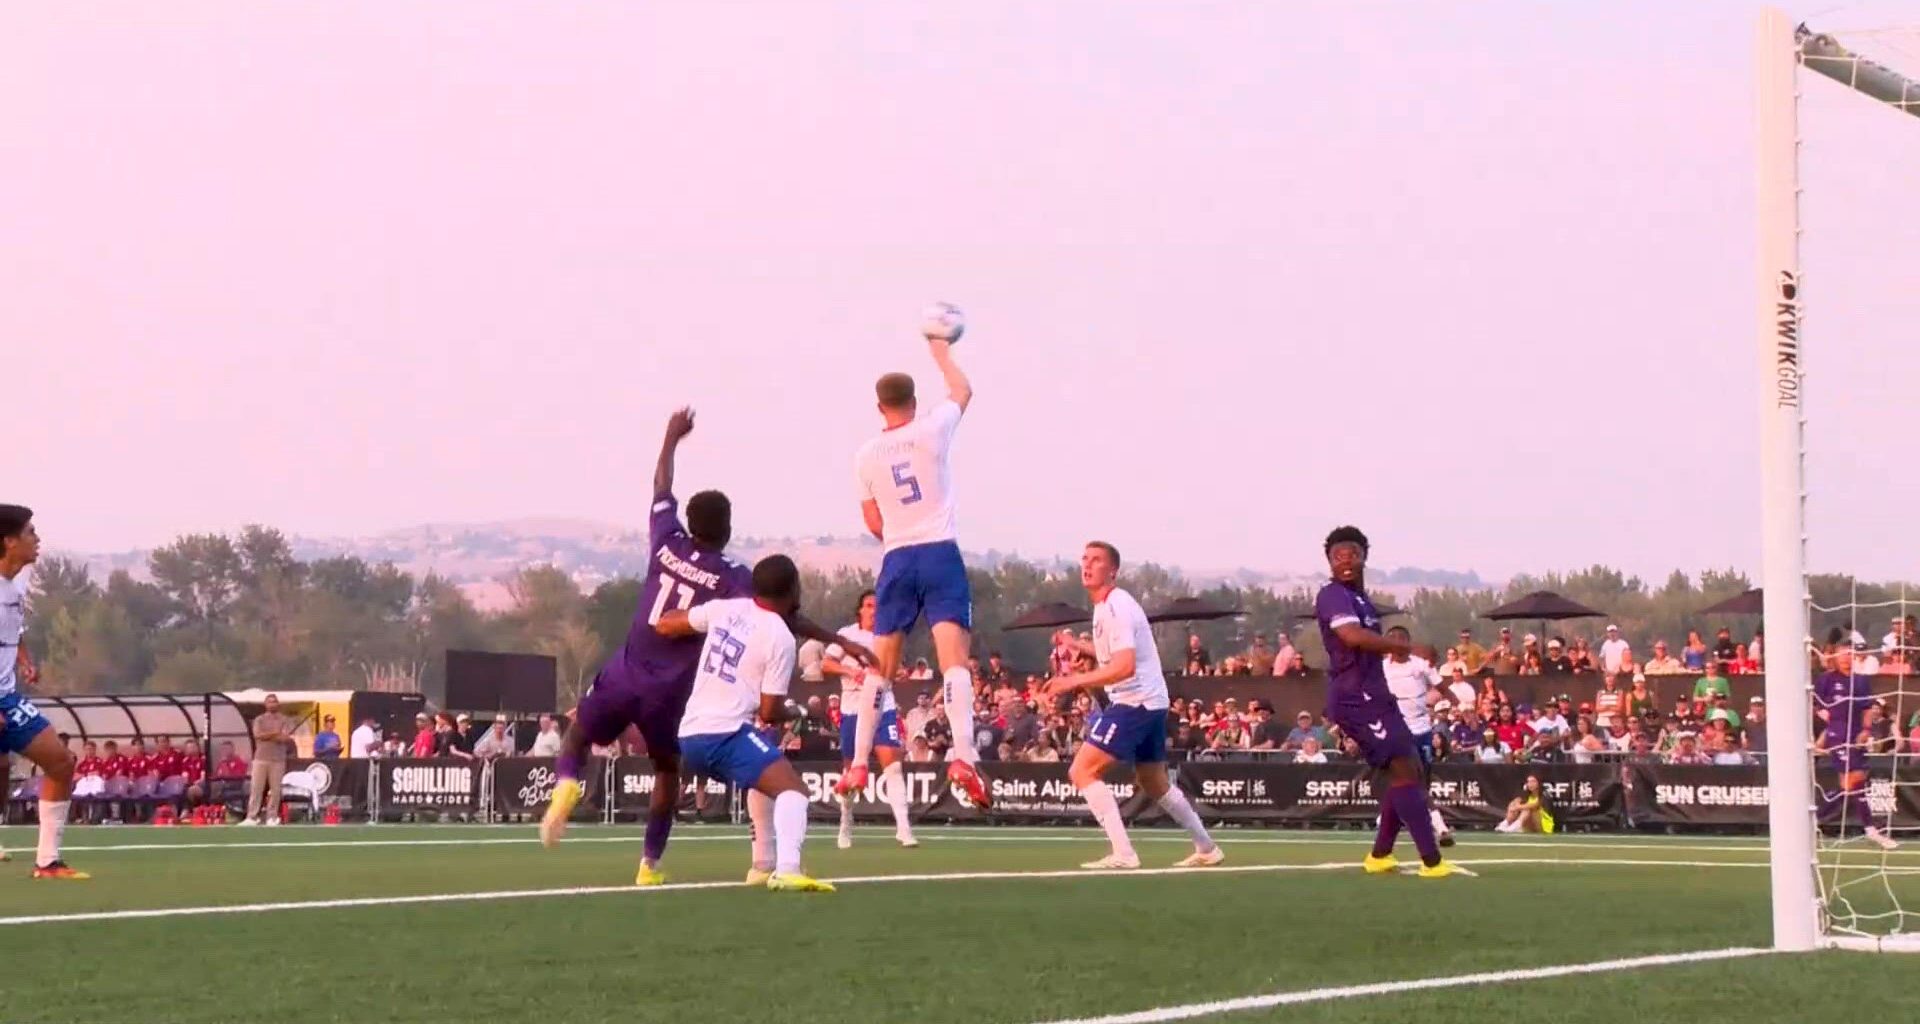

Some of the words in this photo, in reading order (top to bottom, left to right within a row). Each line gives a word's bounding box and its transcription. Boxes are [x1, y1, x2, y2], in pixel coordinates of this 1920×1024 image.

[892, 461, 922, 505] 5
[648, 572, 695, 626] 11
[704, 626, 746, 684] 22
[623, 774, 656, 794] SUN
[992, 779, 1036, 797] Saint
[1041, 779, 1134, 801] Alpsus
[1202, 780, 1245, 797] SRF
[1306, 781, 1350, 797] SRF
[1655, 784, 1694, 805] SUN
[392, 795, 422, 804] HARD
[435, 795, 470, 804] CIDER
